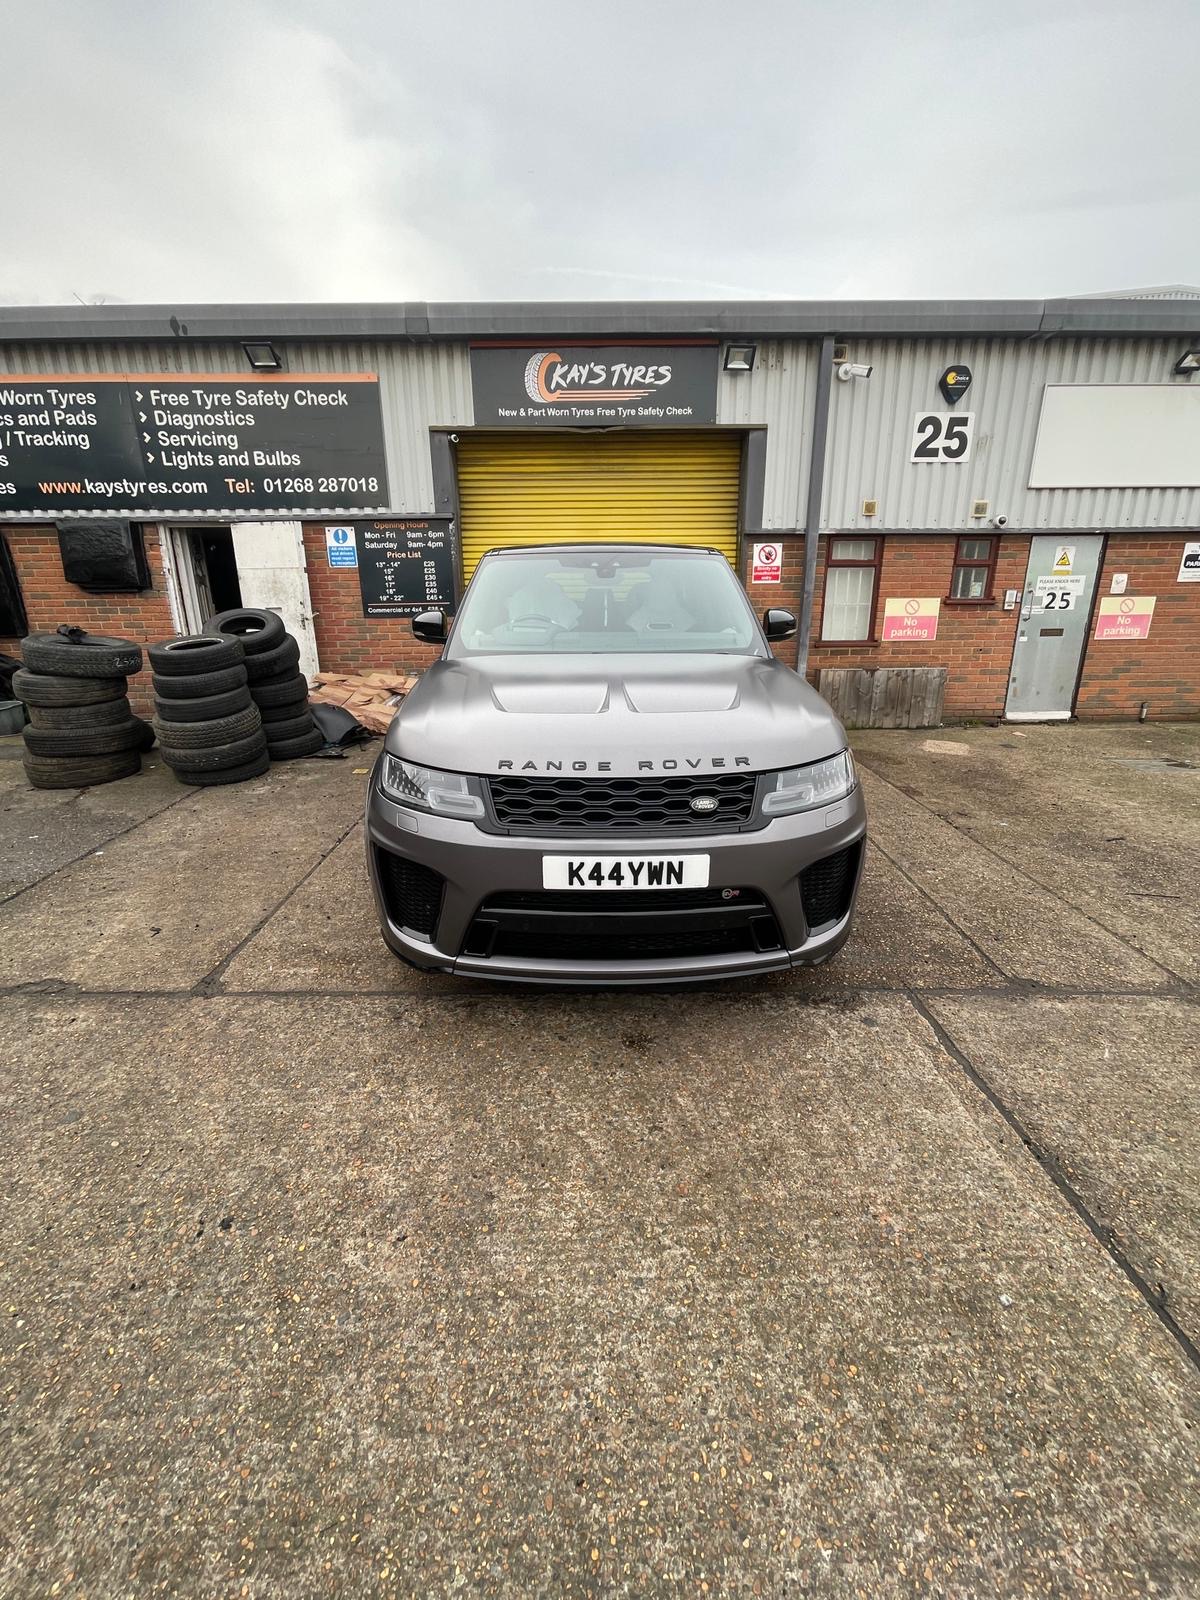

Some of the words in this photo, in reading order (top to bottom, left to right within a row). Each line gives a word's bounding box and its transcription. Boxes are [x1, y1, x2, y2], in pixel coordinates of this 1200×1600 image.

[551, 362, 606, 390] KAY'S
[611, 363, 672, 386] TYRES
[47, 389, 97, 409] Tyres
[150, 390, 189, 406] Free
[192, 390, 231, 409] Tyre
[235, 390, 289, 409] Safety
[294, 390, 348, 406] Check
[18, 410, 50, 426] and
[54, 409, 97, 426] Pads
[154, 410, 255, 430] Diagnostics
[498, 408, 518, 417] New
[519, 408, 527, 417] &
[528, 408, 546, 417] Part
[547, 408, 570, 416] Worn
[571, 407, 594, 418] Tyres
[597, 408, 616, 416] Free
[617, 407, 636, 418] Tyre
[638, 407, 665, 418] Safety
[666, 406, 693, 416] Check
[13, 430, 90, 450] Tracking
[158, 431, 239, 449] Servicing
[914, 415, 970, 460] 25
[161, 451, 214, 469] Lights
[218, 451, 249, 466] and
[254, 451, 301, 466] Bulbs
[38, 479, 208, 497] www.kaystyres.com
[224, 478, 255, 493] Tel:
[263, 478, 314, 493] 01268
[318, 477, 379, 493] 287018
[374, 522, 405, 530] Opening
[386, 531, 396, 539] Fri
[428, 531, 445, 539] 6pm
[365, 541, 398, 549] Saturday
[427, 540, 444, 549] 4pm
[1045, 592, 1071, 610] 25
[904, 616, 918, 626] No
[1117, 616, 1131, 625] No
[890, 627, 928, 639] parking
[1103, 626, 1140, 637] parking
[498, 759, 611, 771] RANGE
[638, 756, 751, 771] ROVER
[567, 861, 684, 886] K44YWN
